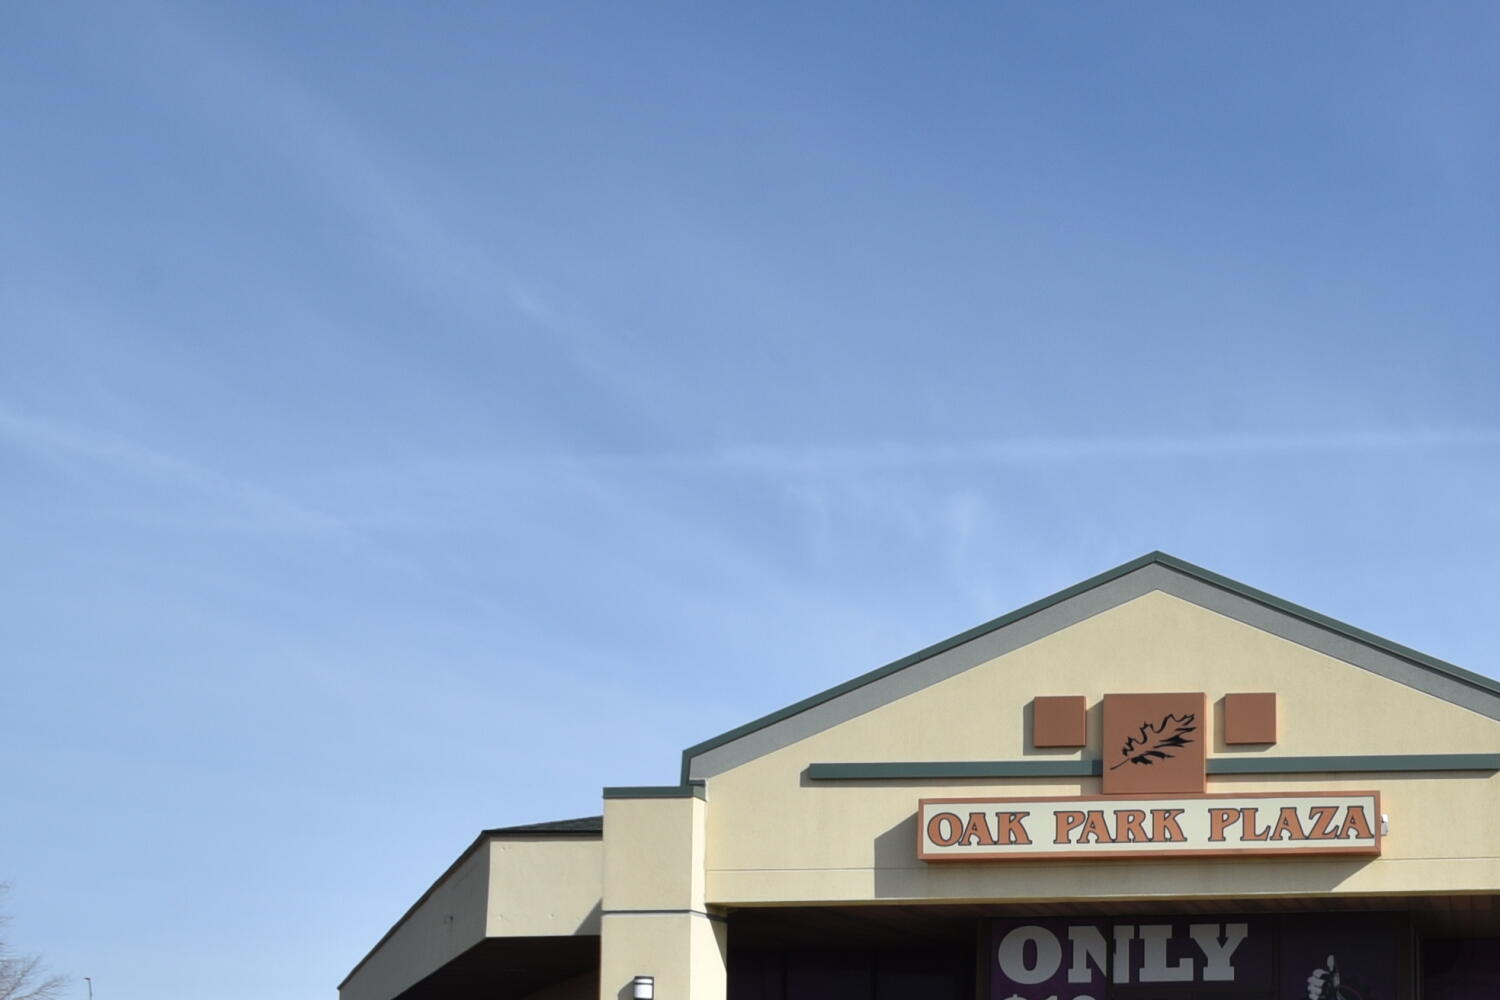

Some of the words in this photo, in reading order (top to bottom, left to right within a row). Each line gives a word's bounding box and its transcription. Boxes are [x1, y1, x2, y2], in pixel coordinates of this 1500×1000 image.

[926, 811, 1032, 847] OAK
[1053, 809, 1187, 844] PARK
[1208, 806, 1375, 842] PLAZA
[998, 923, 1249, 985] ONLY
